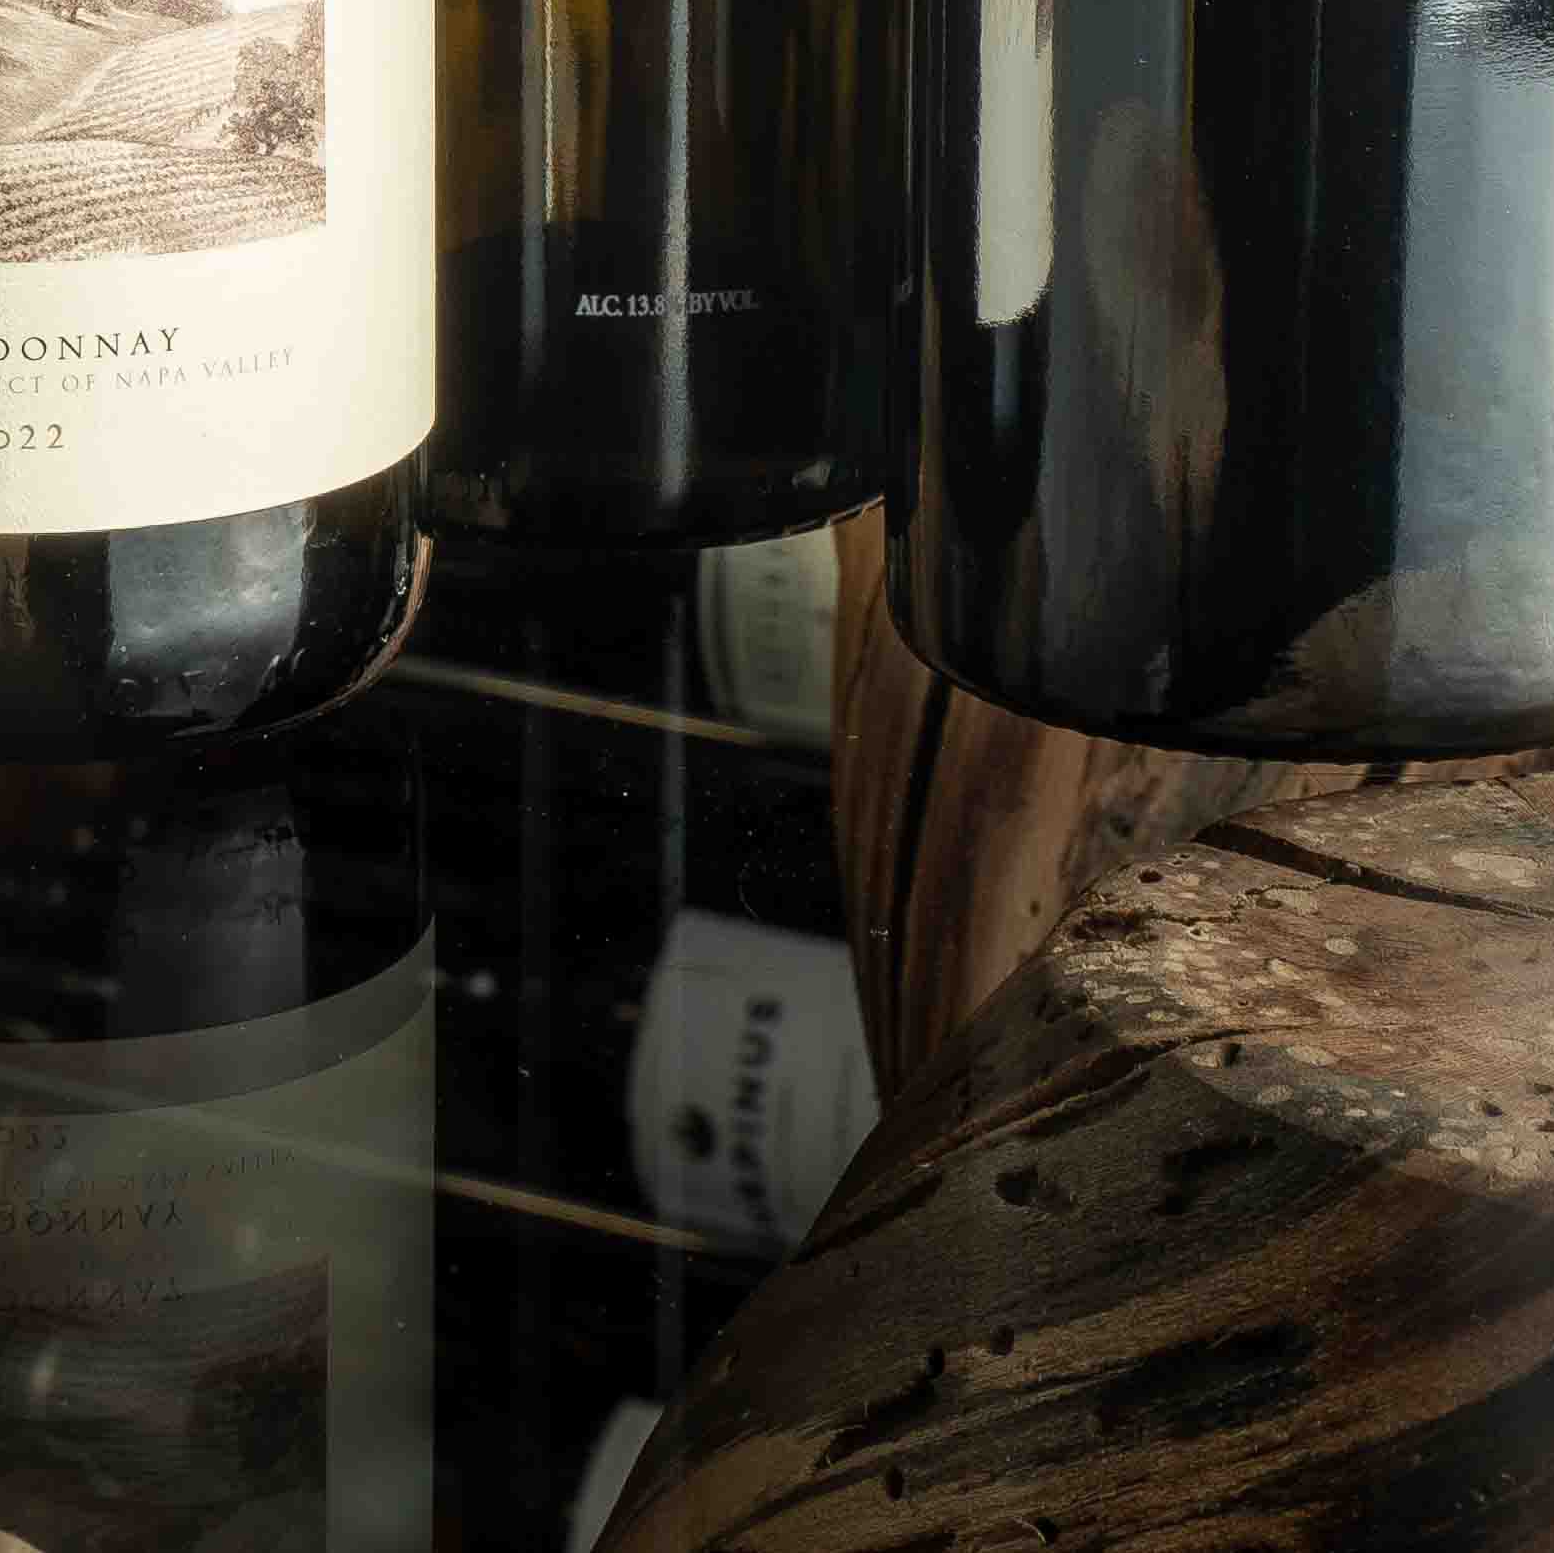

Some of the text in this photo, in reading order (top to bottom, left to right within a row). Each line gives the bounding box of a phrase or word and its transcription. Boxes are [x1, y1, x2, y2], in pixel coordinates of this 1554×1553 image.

[575, 293, 623, 317] ALC.
[627, 293, 686, 318] 13.8
[61, 372, 96, 393] OF
[115, 367, 188, 390] NAPA
[201, 346, 296, 379] VALLEY
